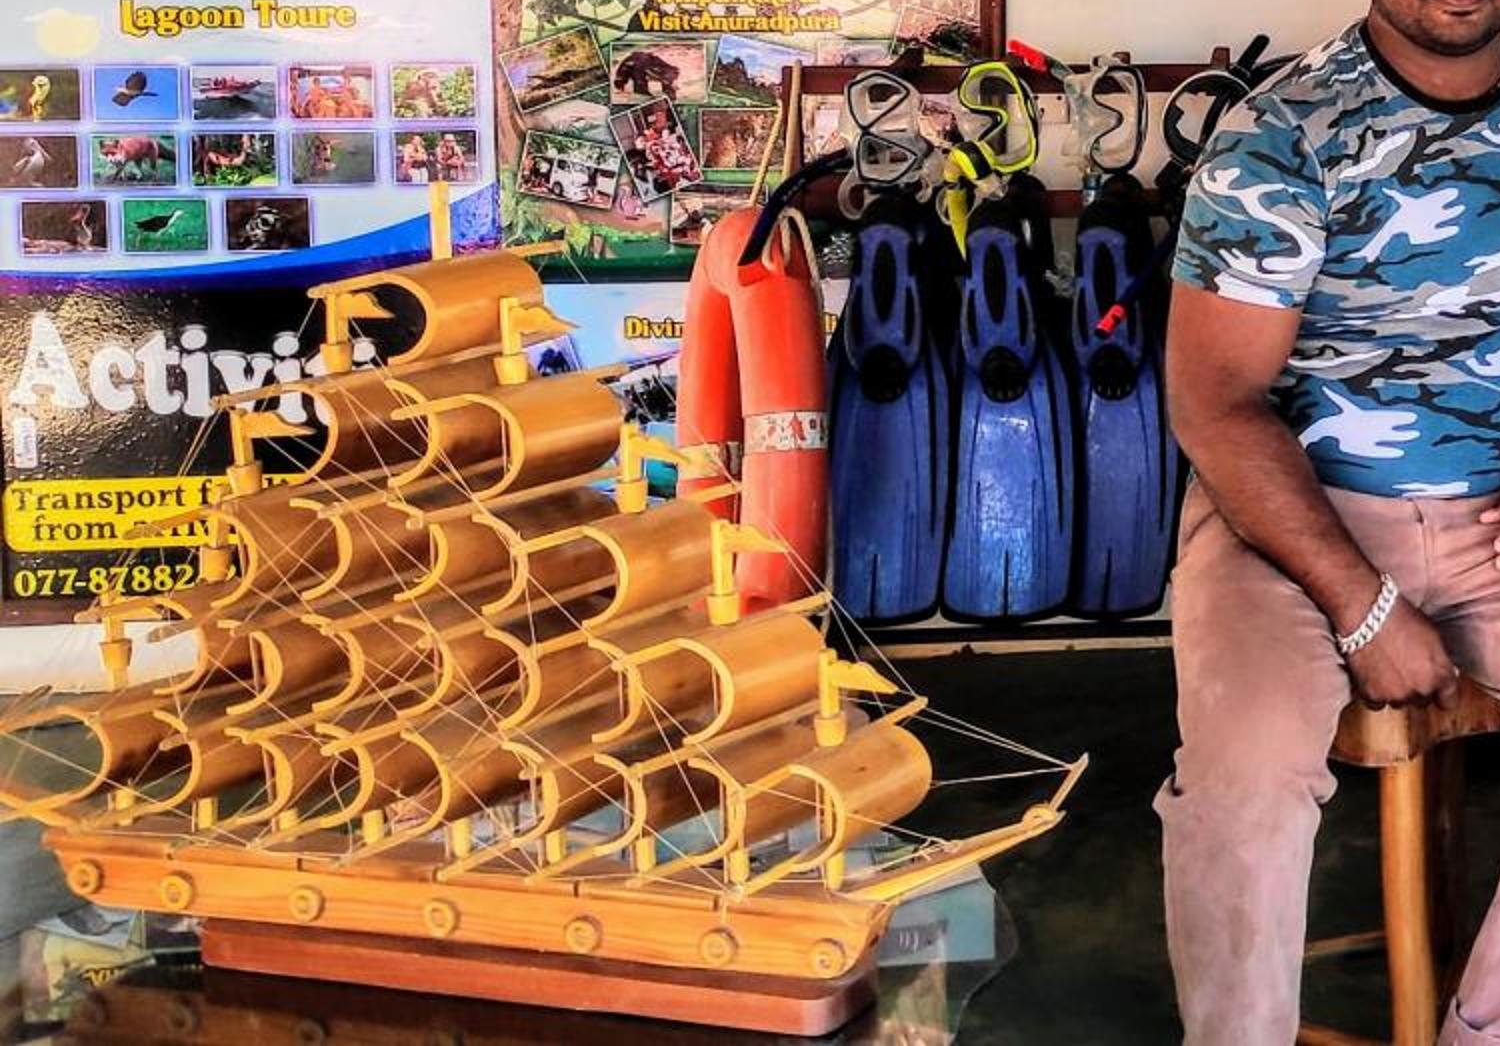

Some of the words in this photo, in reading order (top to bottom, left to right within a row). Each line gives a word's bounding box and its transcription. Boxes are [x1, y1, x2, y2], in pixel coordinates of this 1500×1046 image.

[638, 8, 690, 32] Visit
[692, 9, 842, 35] Anuradpura
[11, 486, 187, 515] Transport
[31, 515, 119, 542] from
